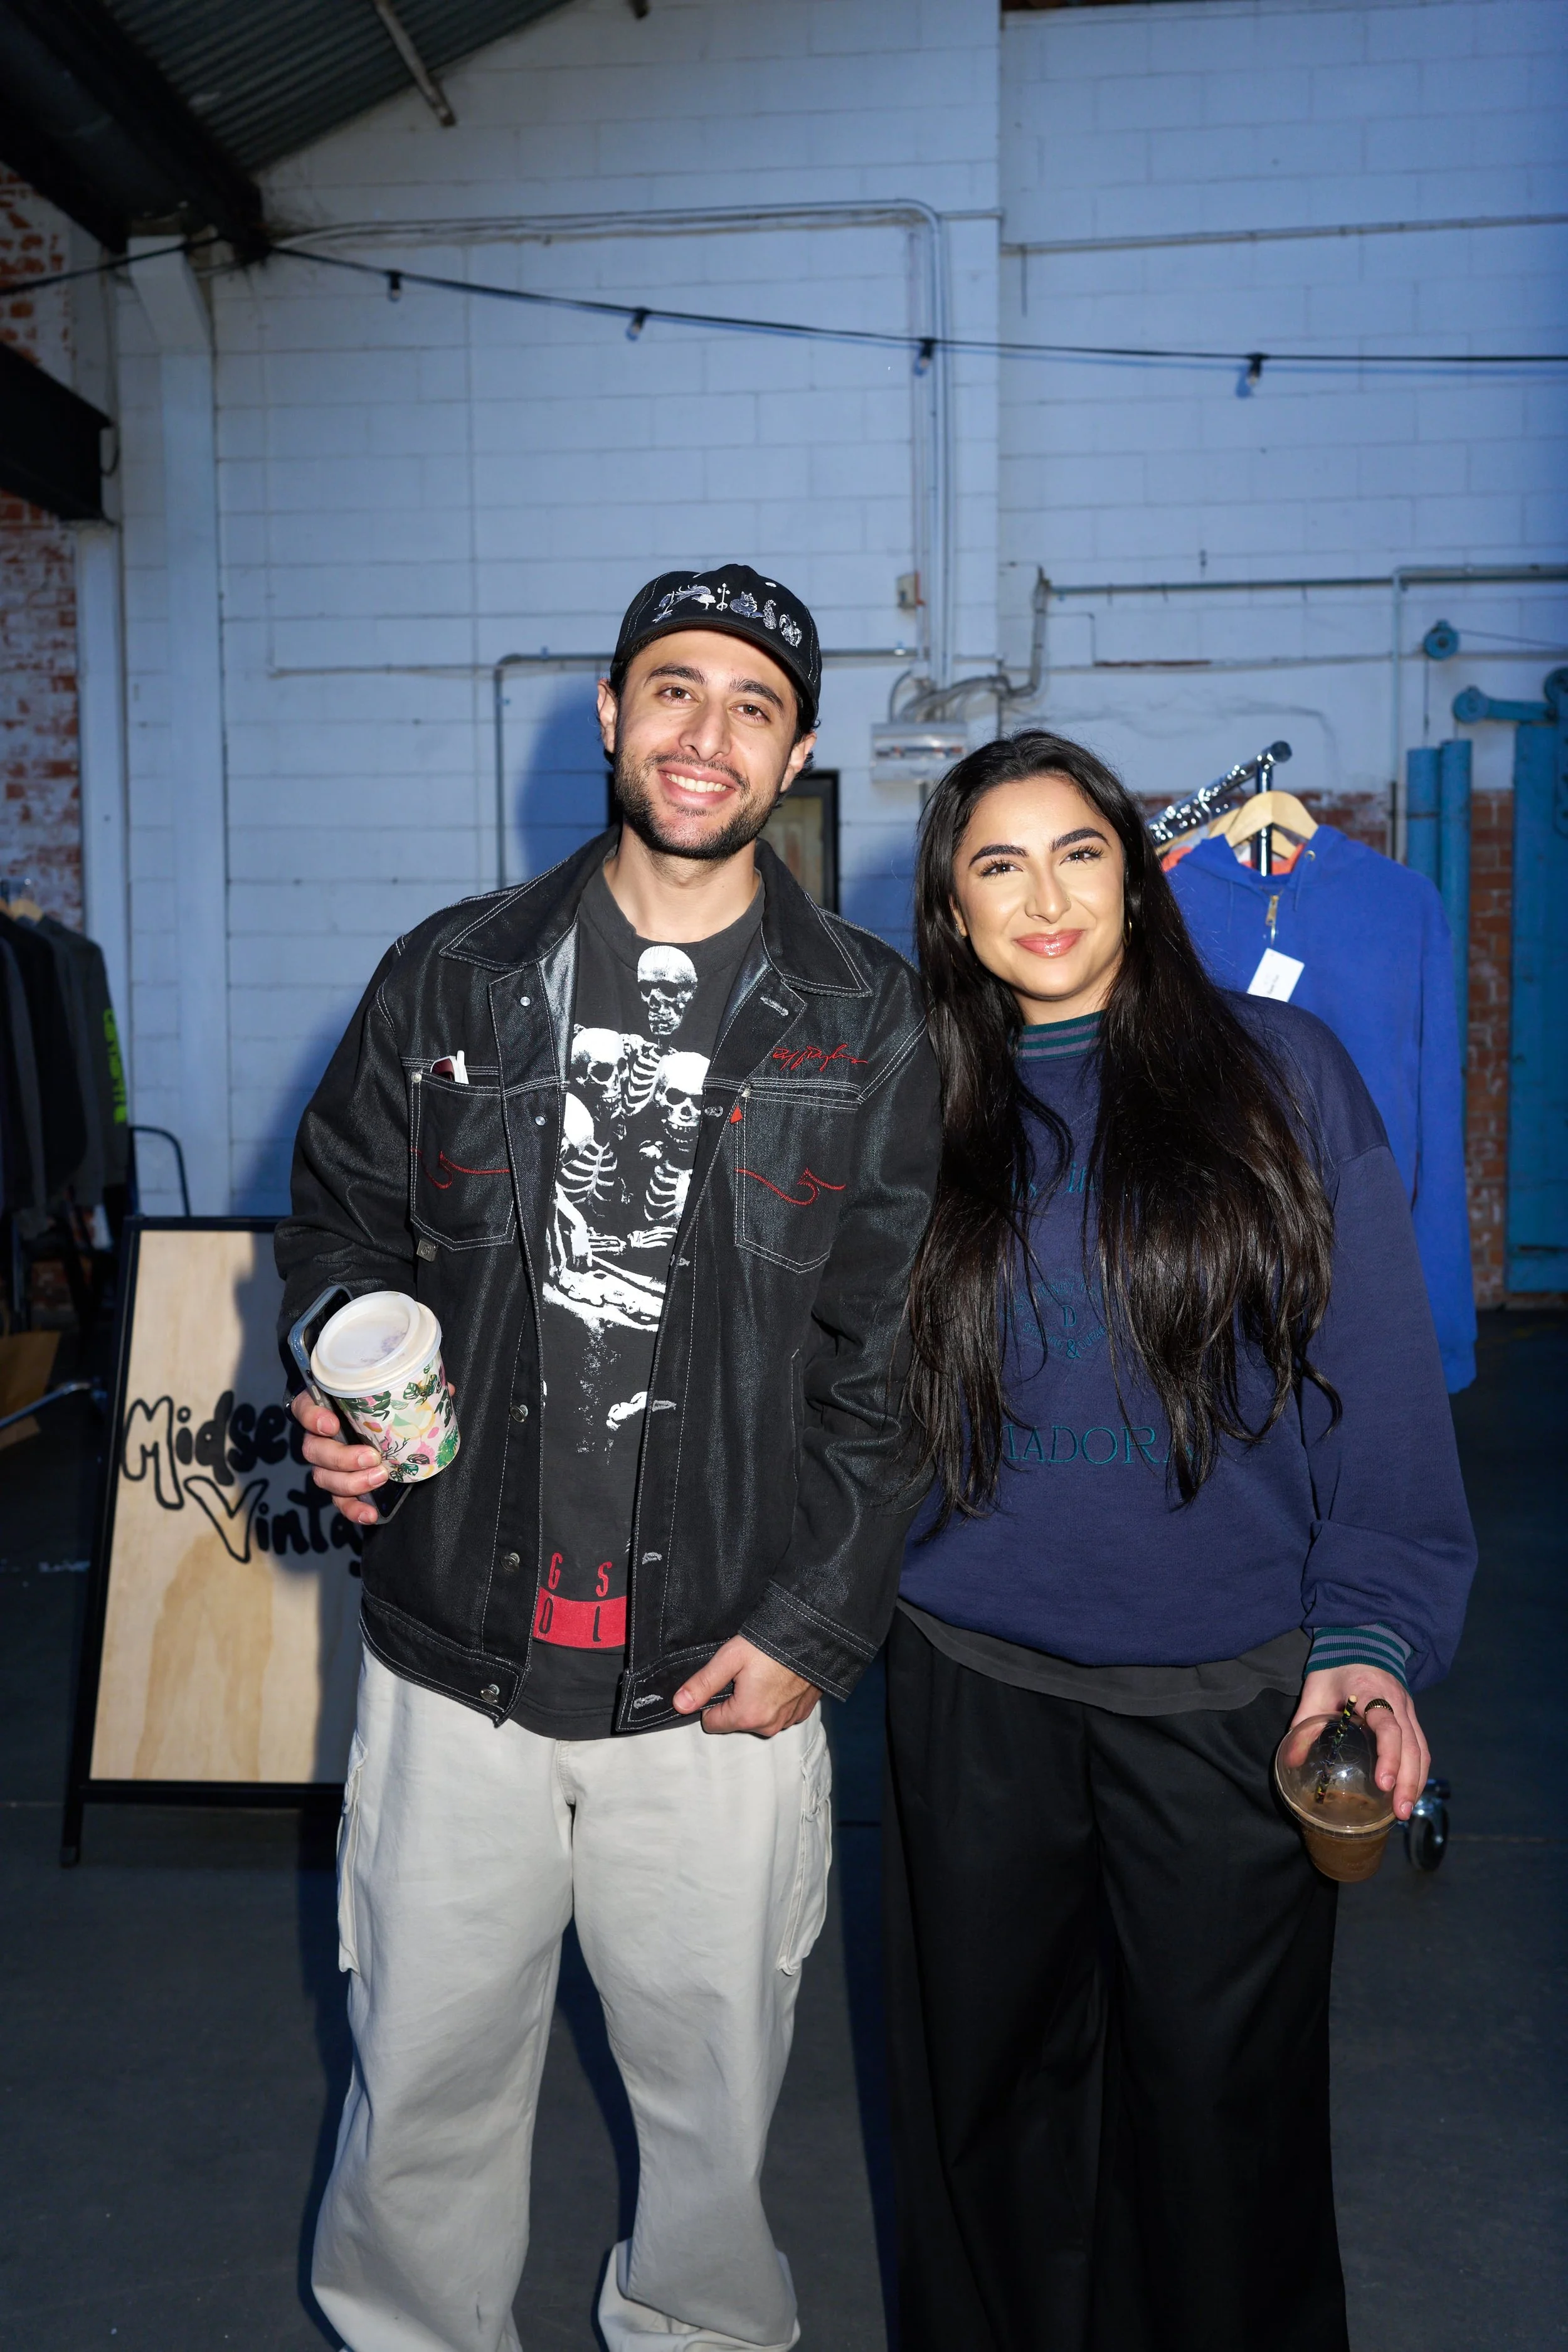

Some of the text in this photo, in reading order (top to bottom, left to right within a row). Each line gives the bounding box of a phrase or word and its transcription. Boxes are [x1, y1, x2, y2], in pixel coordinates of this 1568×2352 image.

[1066, 1338, 1082, 1360] &
[964, 1423, 1199, 1465] IADOR
[183, 1470, 363, 1577] Vinta
